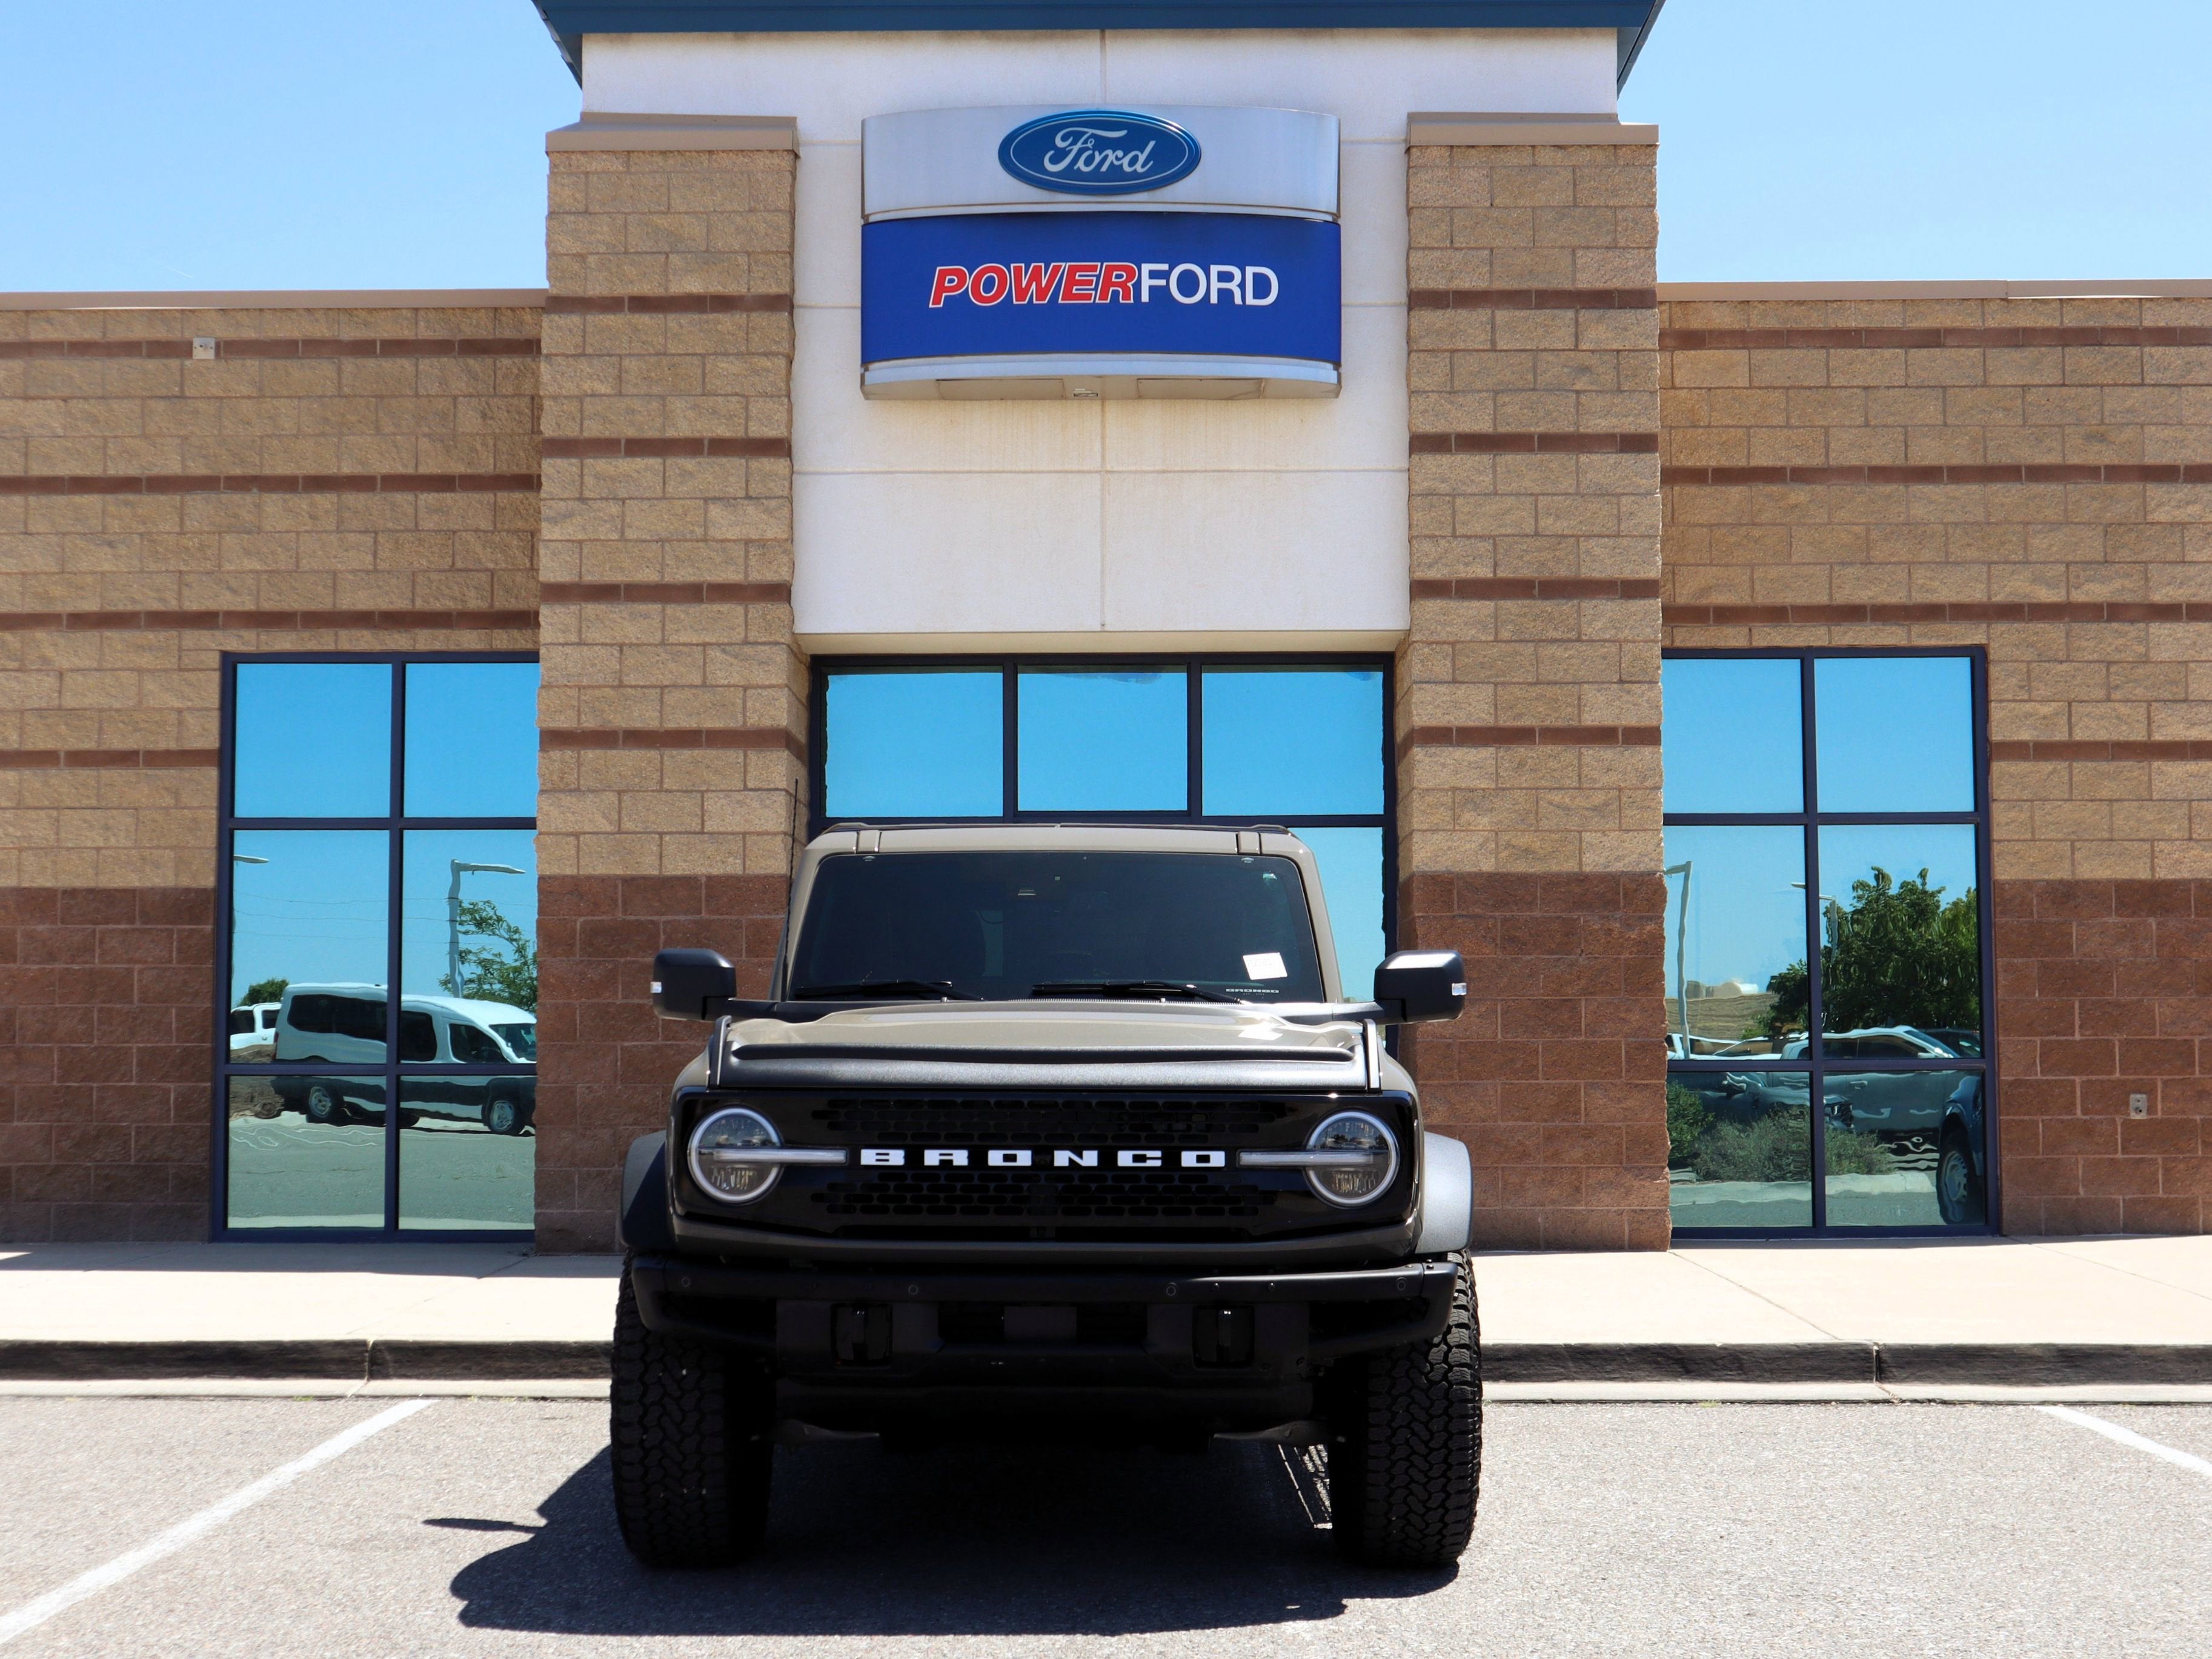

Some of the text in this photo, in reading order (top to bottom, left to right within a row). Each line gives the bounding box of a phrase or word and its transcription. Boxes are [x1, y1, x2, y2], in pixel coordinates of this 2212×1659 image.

[1044, 127, 1155, 173] Ford
[929, 262, 1279, 308] POWERFORD
[860, 1149, 1225, 1167] BRONCO
